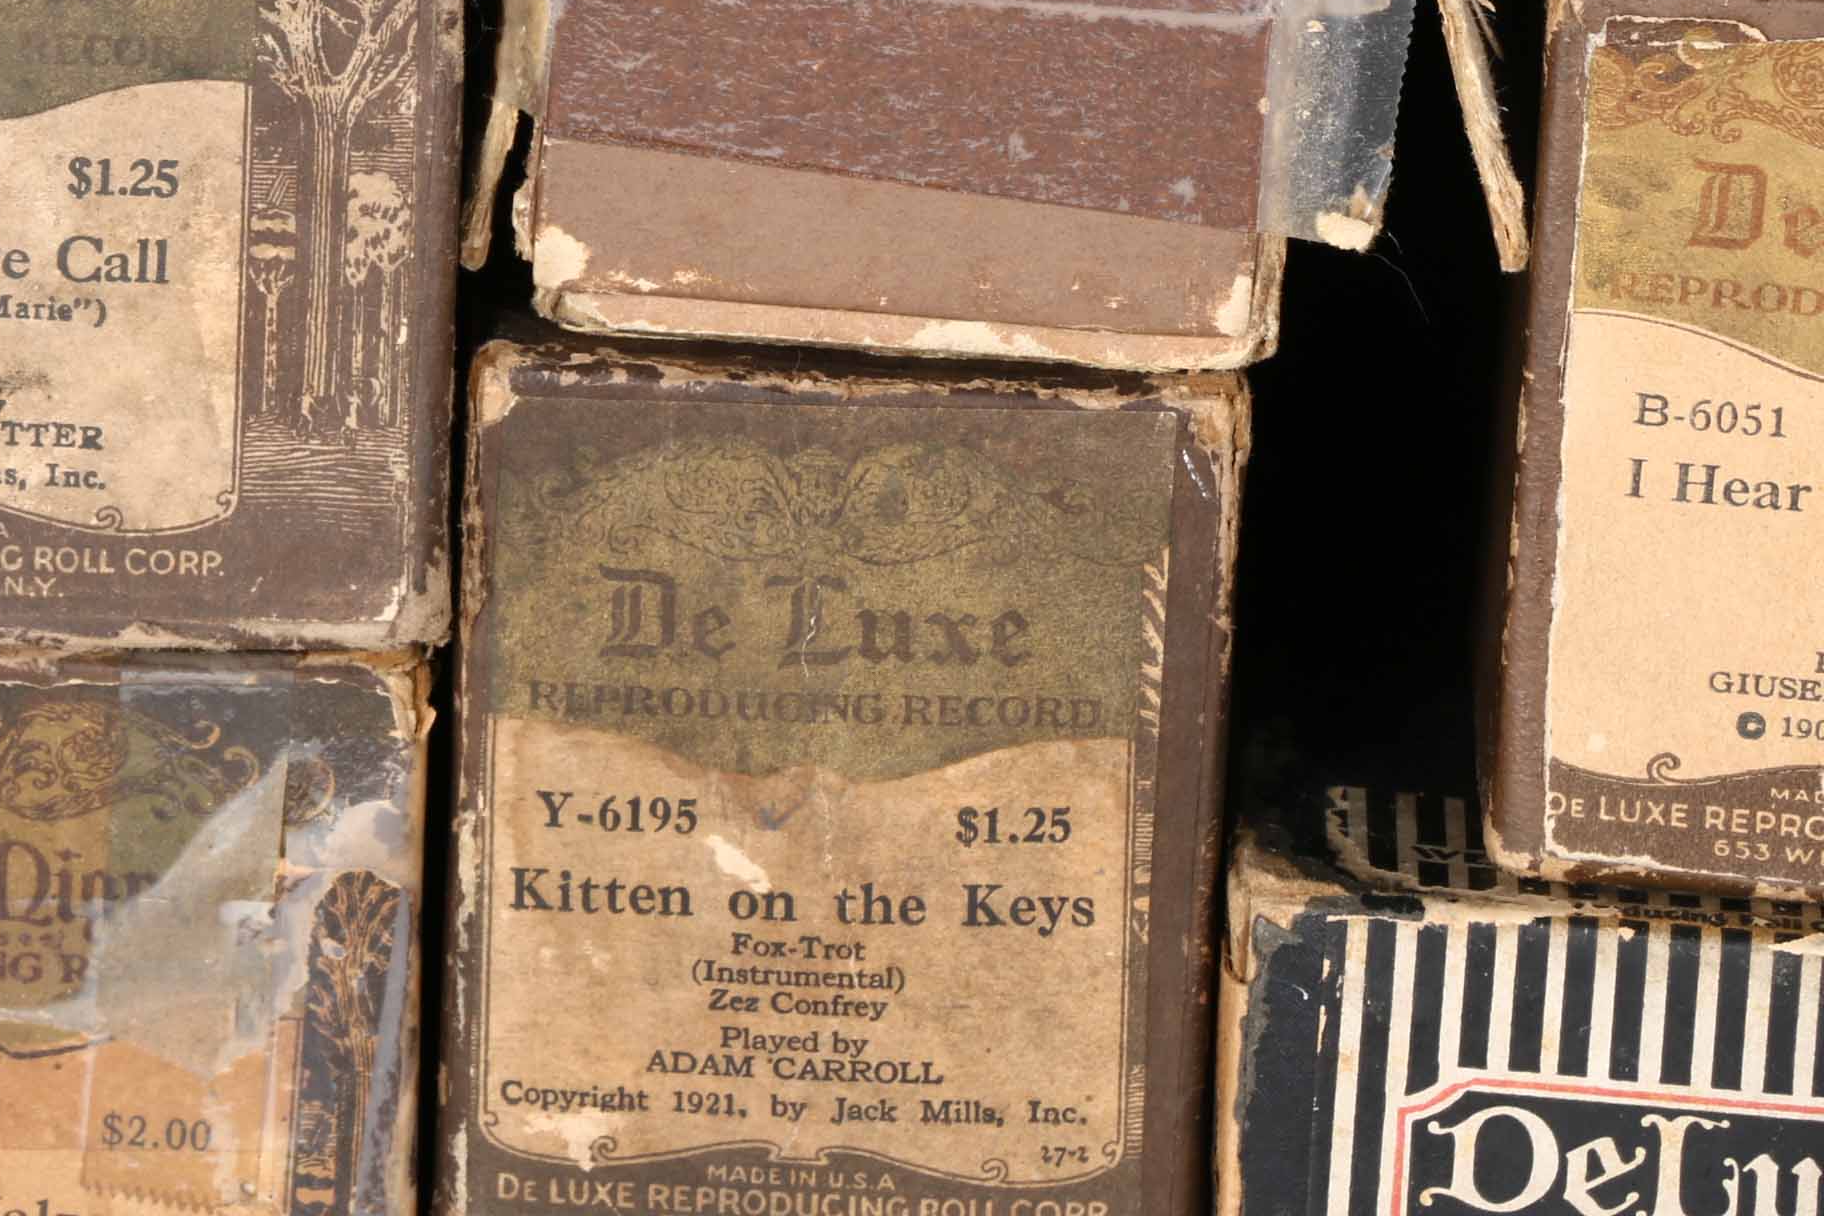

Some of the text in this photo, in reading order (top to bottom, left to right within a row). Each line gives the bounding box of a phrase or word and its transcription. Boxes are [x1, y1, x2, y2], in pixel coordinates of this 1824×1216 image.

[68, 157, 179, 199] $1.25
[56, 235, 170, 285] Call
[1633, 393, 1786, 438] B-6051
[44, 463, 106, 490] Inc.
[1672, 462, 1812, 512] Hear
[34, 547, 115, 573] ROLL
[125, 548, 224, 576] CORP.
[5, 576, 64, 597] N.Y.
[597, 564, 1032, 668] De Luxe
[527, 679, 1101, 730] REPRODUCING RECORD
[536, 790, 1071, 848] Y-6195 $1.25
[1599, 796, 1688, 828] LUXE
[1714, 839, 1770, 861] 653
[510, 868, 1094, 938] Kitten on the Keys
[731, 932, 866, 961] Fox-Trot
[692, 959, 905, 991] (Instrumental)
[708, 988, 888, 1022] Zez Confrey
[720, 1026, 870, 1058] Played by
[646, 1050, 944, 1085] ADAM CARROLL
[500, 1080, 650, 1113] Copyright
[770, 1094, 807, 1123] by
[830, 1097, 898, 1126] Jack
[920, 1100, 1004, 1128] Mills,
[1027, 1099, 1087, 1126] Inc.
[101, 1110, 211, 1151] $2.00
[707, 1165, 816, 1187] MADE IN
[550, 1179, 634, 1208] LUXE
